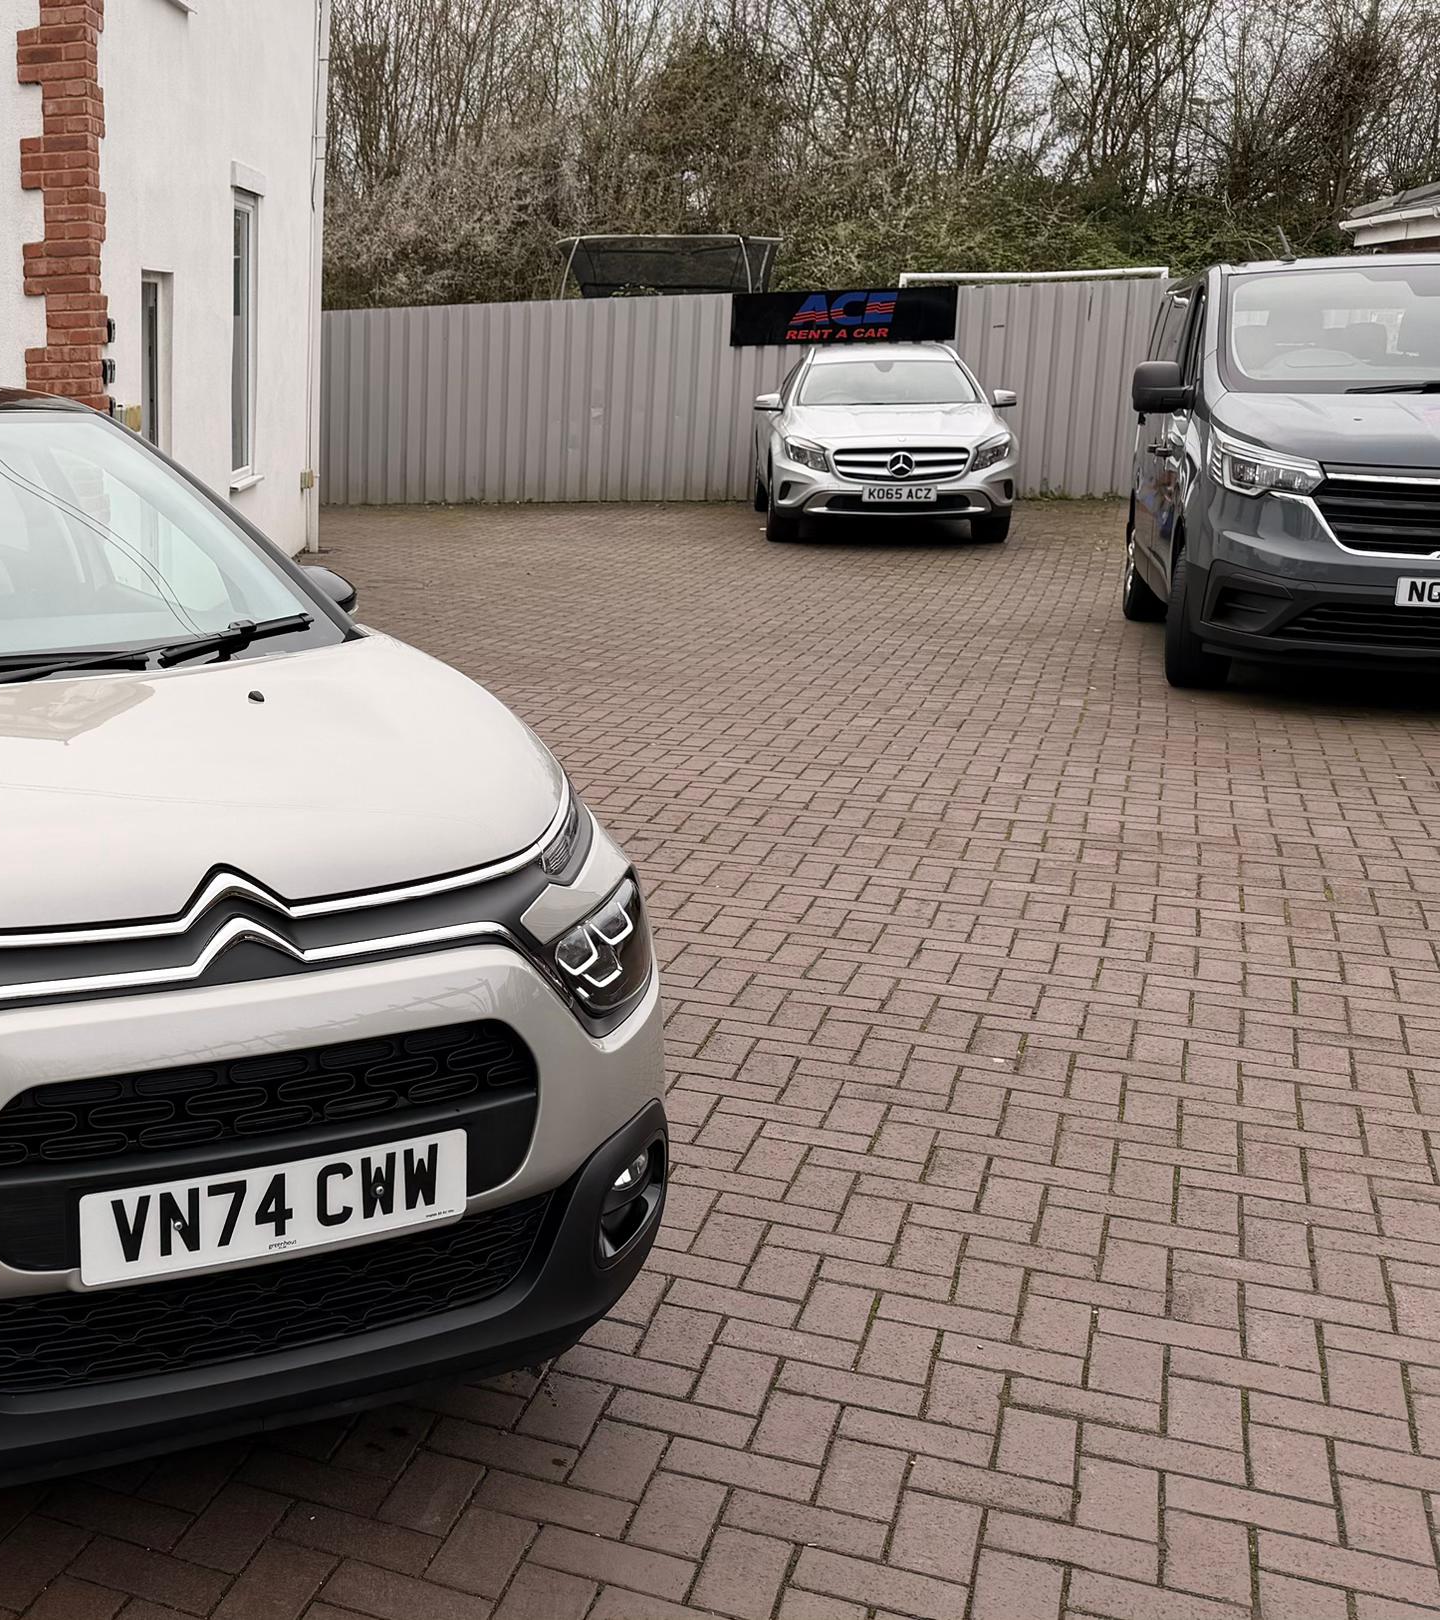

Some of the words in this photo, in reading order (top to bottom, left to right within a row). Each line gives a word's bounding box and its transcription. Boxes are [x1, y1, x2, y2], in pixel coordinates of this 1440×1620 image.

[788, 291, 898, 326] ACE
[785, 329, 833, 340] RENT
[835, 329, 848, 338] A
[853, 328, 889, 338] CAR
[906, 487, 932, 500] ACZ
[110, 1172, 294, 1264] VN74
[316, 1142, 440, 1228] CWW
